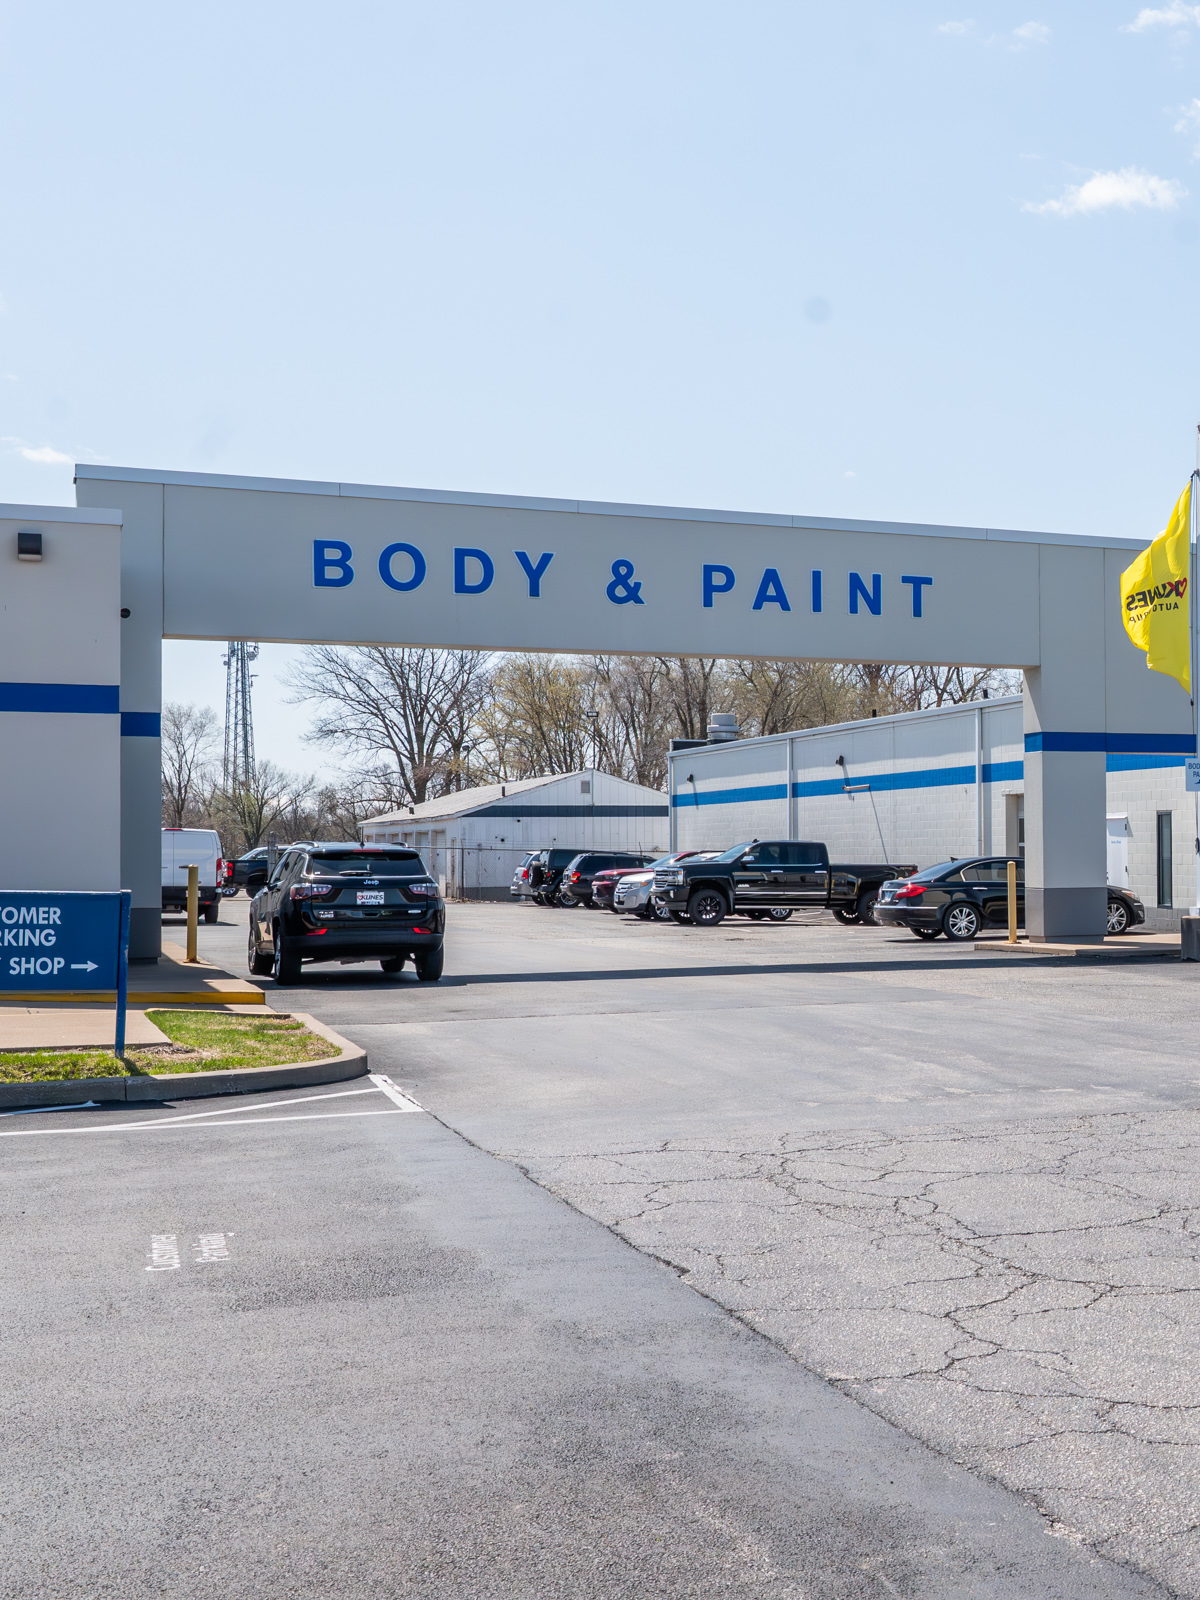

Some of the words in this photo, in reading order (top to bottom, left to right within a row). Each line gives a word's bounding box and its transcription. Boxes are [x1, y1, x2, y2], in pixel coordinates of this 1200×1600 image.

[313, 539, 555, 599] BODY
[605, 558, 647, 605] &
[702, 563, 934, 618] PAINT
[0, 906, 62, 925] OMER
[0, 928, 57, 947] KING
[9, 957, 66, 975] SHOP
[144, 1233, 182, 1271] Customer
